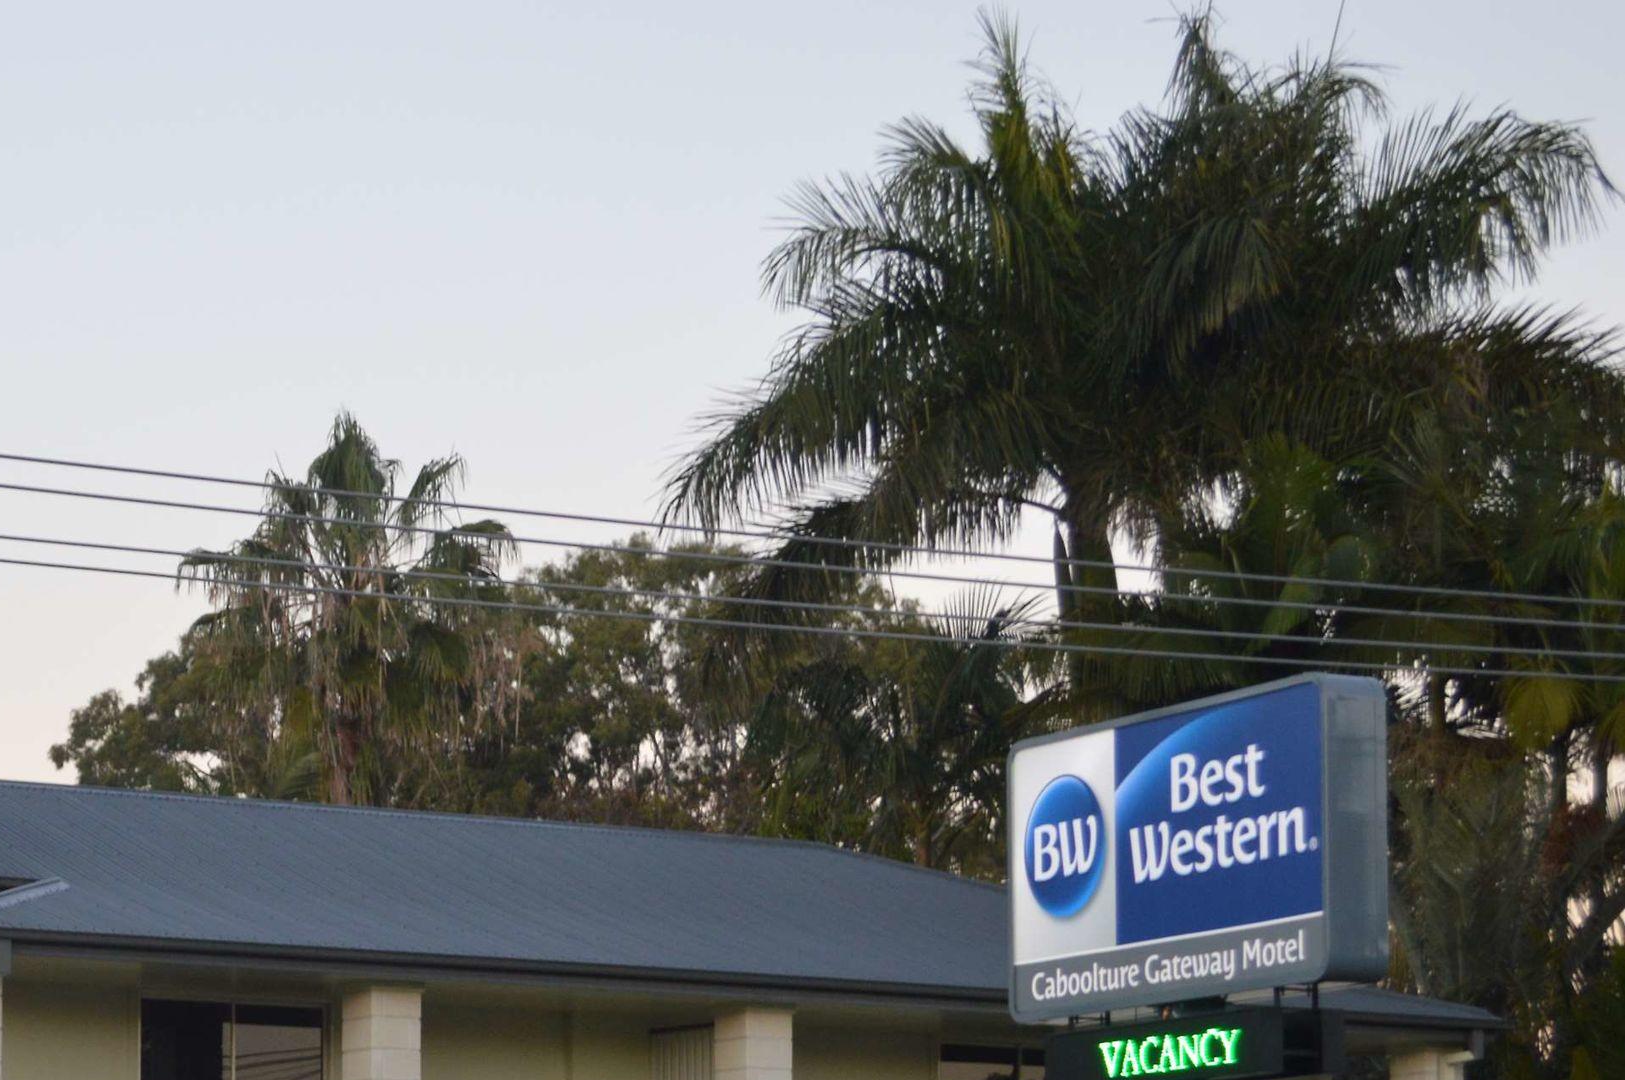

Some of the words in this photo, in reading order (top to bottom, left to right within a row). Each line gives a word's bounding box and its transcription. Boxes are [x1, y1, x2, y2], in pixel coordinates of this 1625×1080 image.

[1170, 743, 1266, 813] Best
[1033, 814, 1097, 883] BW
[1032, 962, 1139, 1001] Caboolture
[1145, 951, 1236, 982] Gateway
[1242, 929, 1305, 970] Motel
[1099, 1027, 1243, 1079] VACANCY
